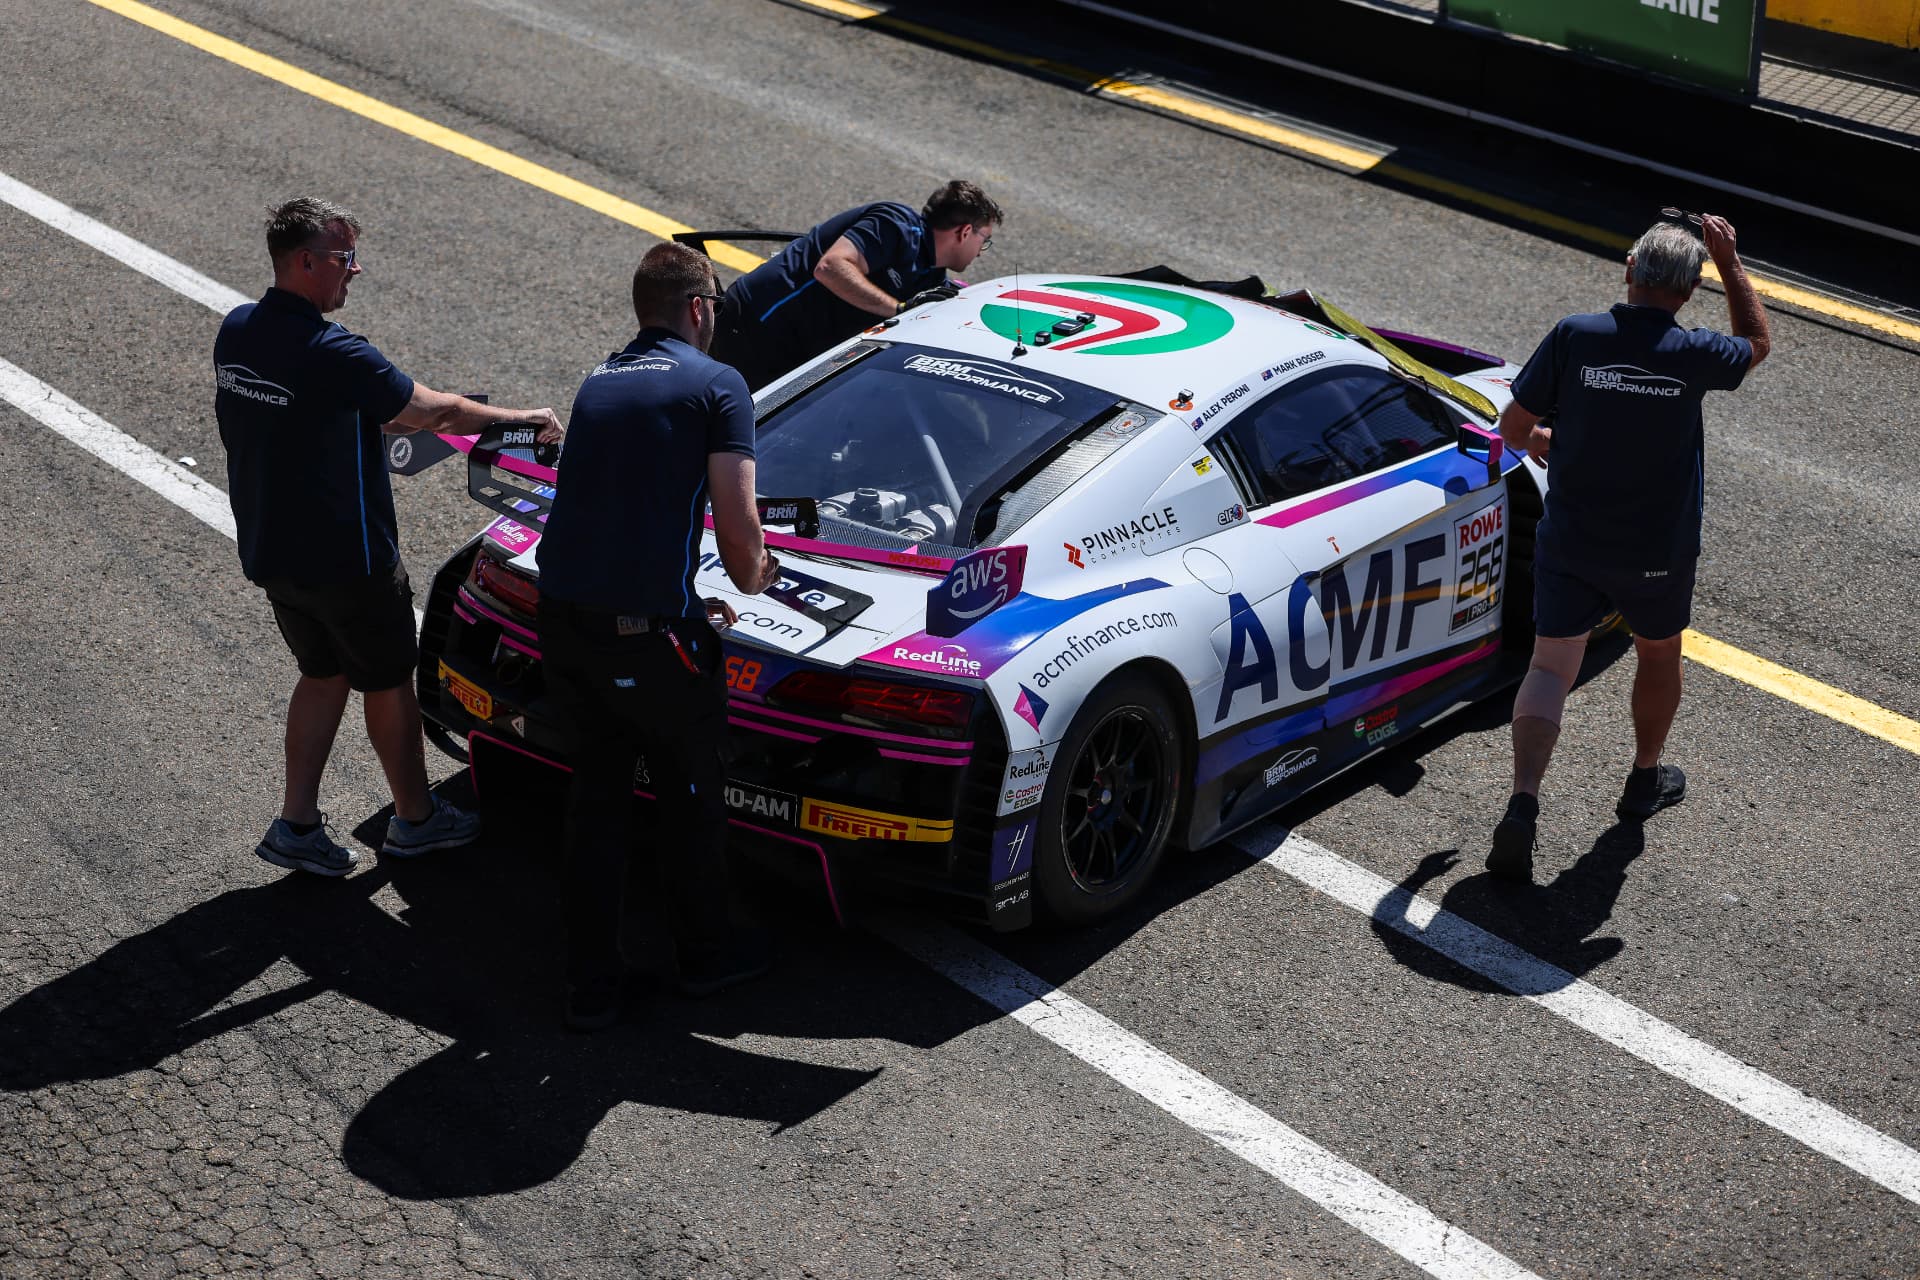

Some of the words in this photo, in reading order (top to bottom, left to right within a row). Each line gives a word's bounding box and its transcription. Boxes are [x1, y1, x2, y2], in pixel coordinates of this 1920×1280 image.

[914, 356, 973, 374] BRM
[1272, 360, 1296, 376] MARK
[1297, 350, 1326, 367] ROSSER
[1585, 369, 1622, 382] BRM
[904, 362, 1052, 404] PERFORMANCE
[1584, 380, 1681, 396] PERFORMANCE
[1202, 402, 1223, 422] ALEX
[1221, 383, 1250, 407] PERONI
[502, 431, 535, 444] BRM
[767, 506, 797, 519] BRM
[1218, 508, 1234, 526] elf
[1081, 507, 1178, 554] PINNACLE
[1459, 505, 1503, 549] ROWE
[1091, 526, 1181, 564] COMPOSITES
[952, 550, 1007, 599] aws
[1457, 535, 1504, 604] 268
[1214, 534, 1446, 724] ACMF
[893, 647, 981, 670] RedLine
[1033, 611, 1178, 688] acmfinance.com
[941, 665, 980, 677] CAPITAL
[1367, 720, 1400, 746] EDGE
[1010, 760, 1050, 779] RedLine
[1266, 762, 1286, 781] BRM
[1266, 754, 1318, 789] PERFORMANCE
[1014, 793, 1040, 809] EDGE
[1015, 782, 1044, 799] Castrol
[809, 804, 909, 842] PIRELLI
